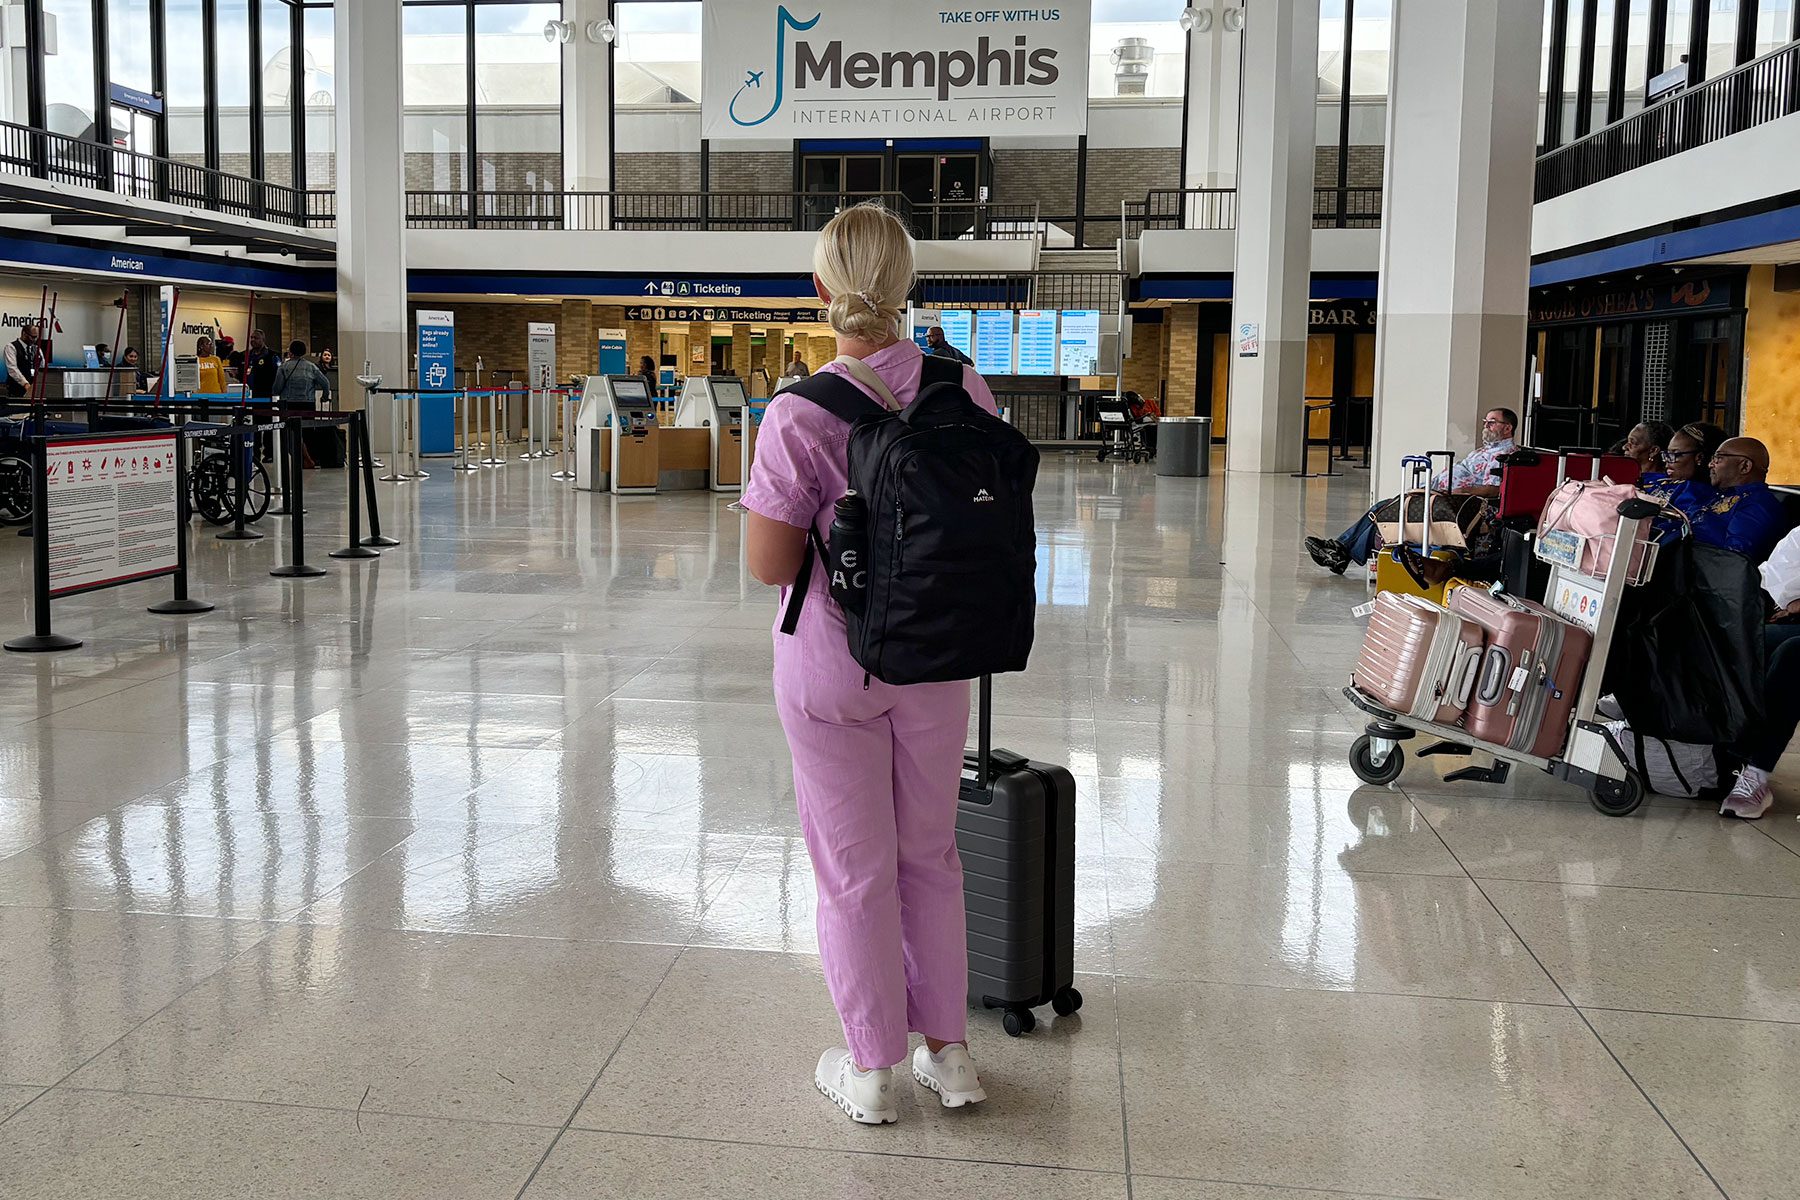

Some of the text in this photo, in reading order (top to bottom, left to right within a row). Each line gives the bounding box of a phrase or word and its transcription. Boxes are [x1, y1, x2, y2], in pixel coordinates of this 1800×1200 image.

[939, 9, 1060, 23] TAKE OFF WITH US
[794, 35, 1059, 101] Memphis
[793, 106, 1056, 123] INTERNATIONAL AIRPORT
[111, 256, 144, 270] American
[680, 283, 741, 295] A Ticketing
[1, 312, 48, 329] American
[718, 311, 726, 319] A
[730, 310, 772, 321] Ticketing
[1309, 309, 1359, 325] BAR
[181, 322, 214, 335] American
[422, 329, 433, 337] Bags
